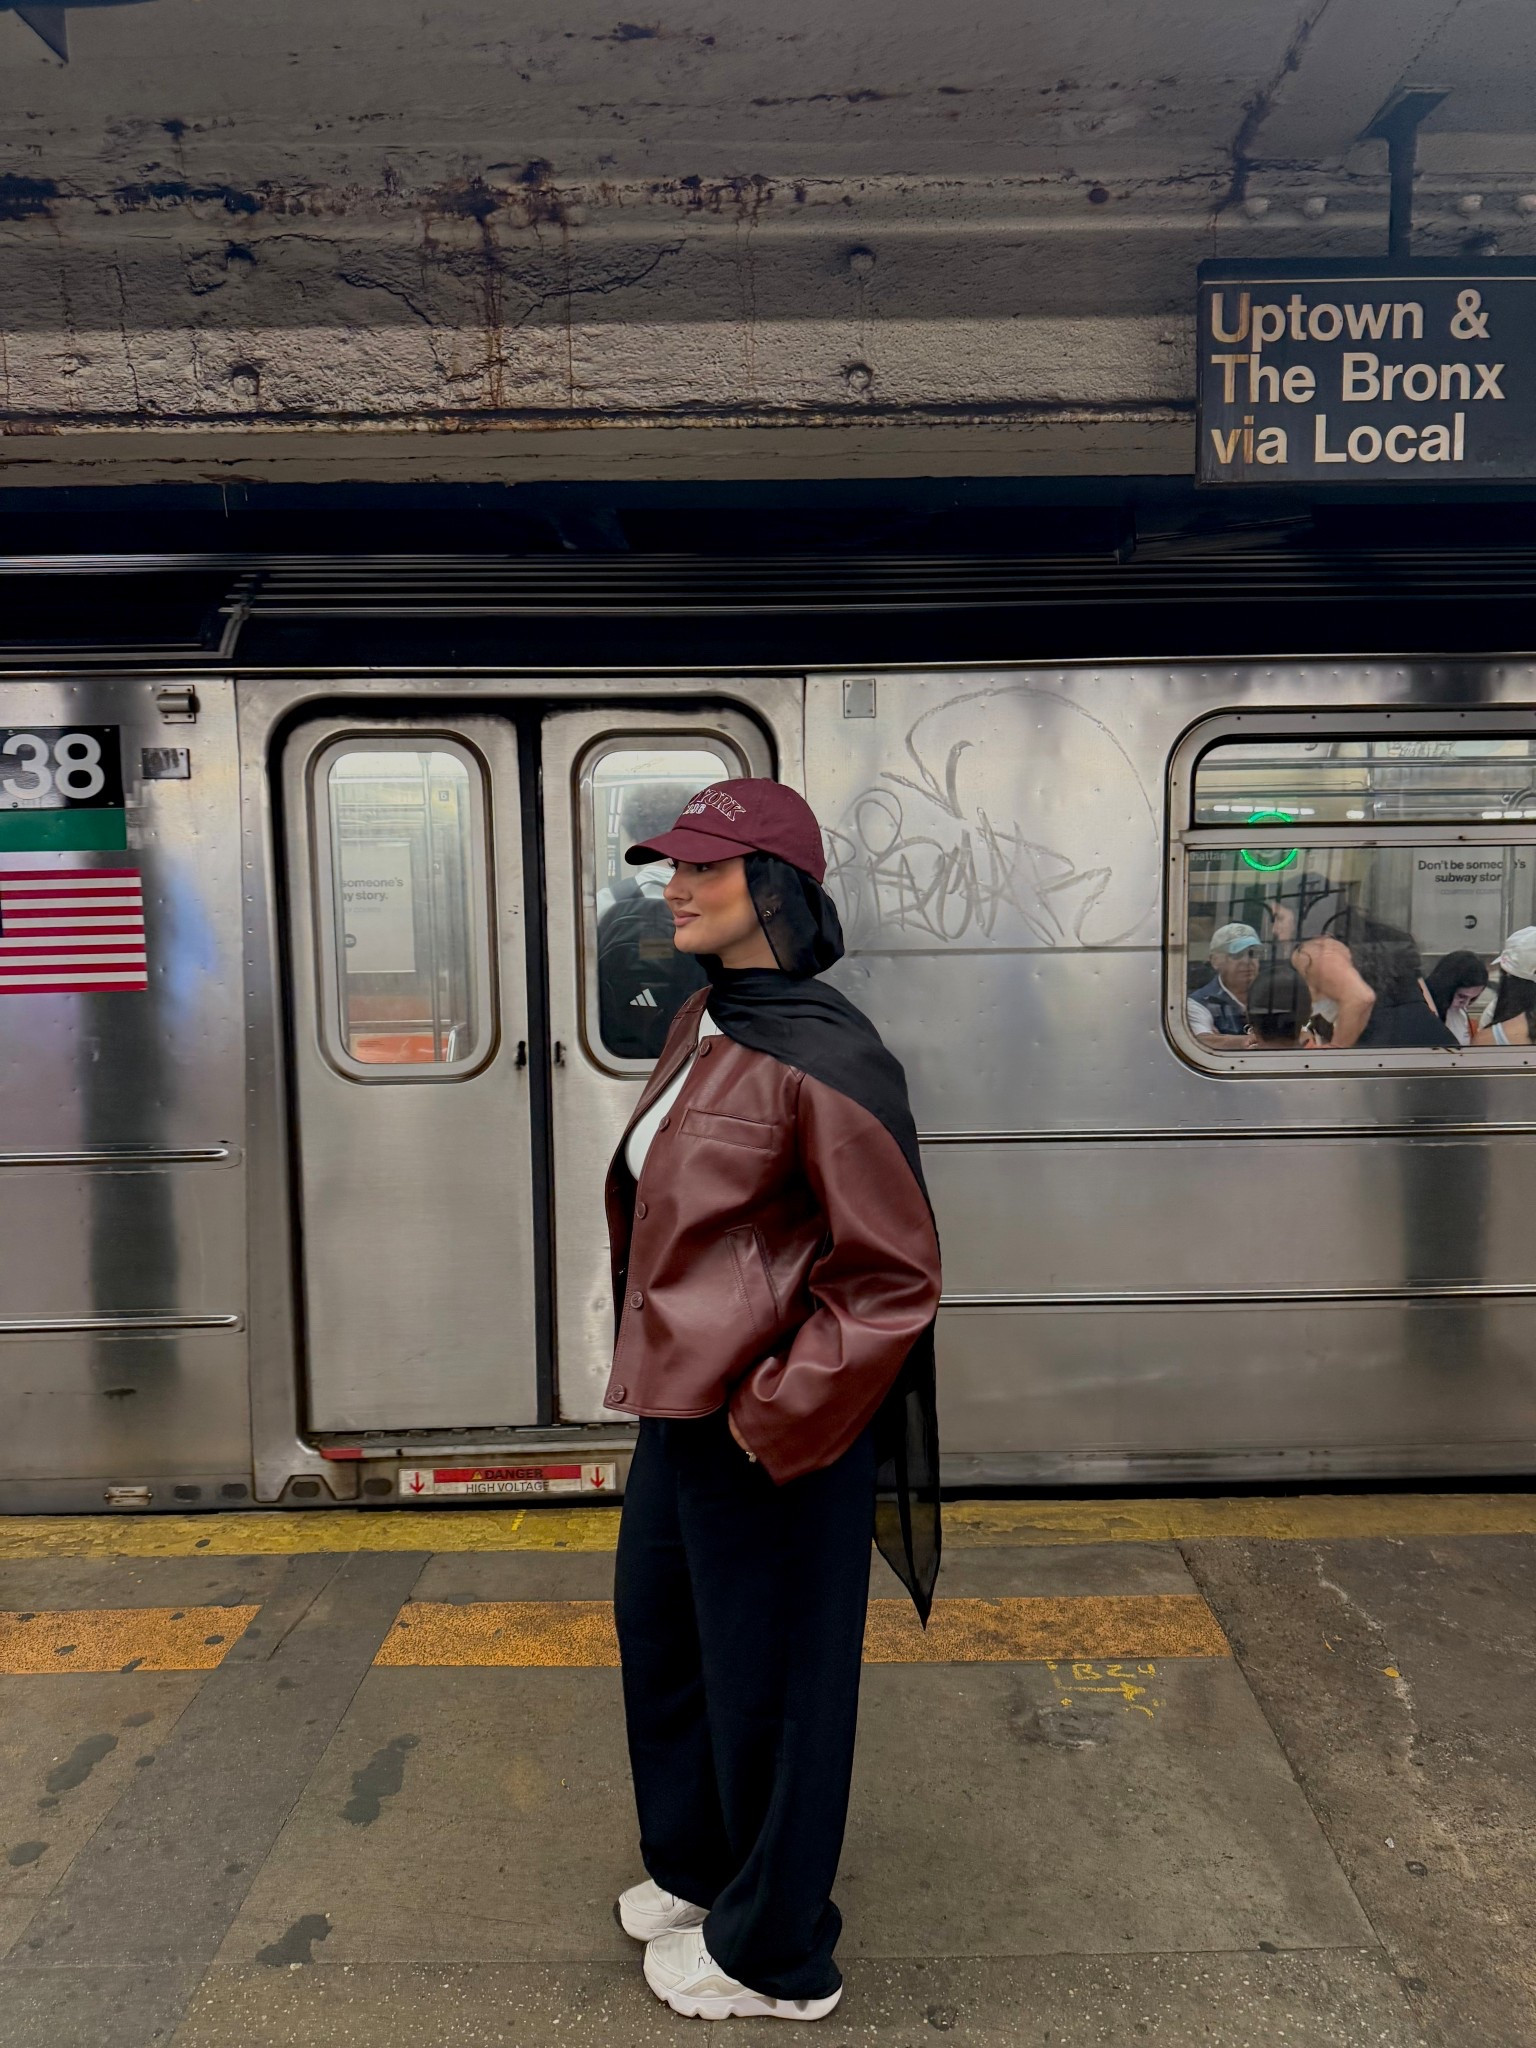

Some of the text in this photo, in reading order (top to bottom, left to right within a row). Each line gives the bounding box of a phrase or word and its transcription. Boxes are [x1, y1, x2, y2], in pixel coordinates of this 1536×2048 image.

[1211, 288, 1490, 352] Uptown &
[1211, 352, 1505, 403] The Bronx
[1211, 412, 1465, 464] via Local
[2, 733, 105, 799] 38
[1418, 859, 1449, 870] Don't
[1450, 860, 1465, 870] be
[1435, 872, 1502, 884] subway stor
[466, 1481, 550, 1494] HIGH VOLTAGE
[485, 1468, 544, 1480] DANGER
